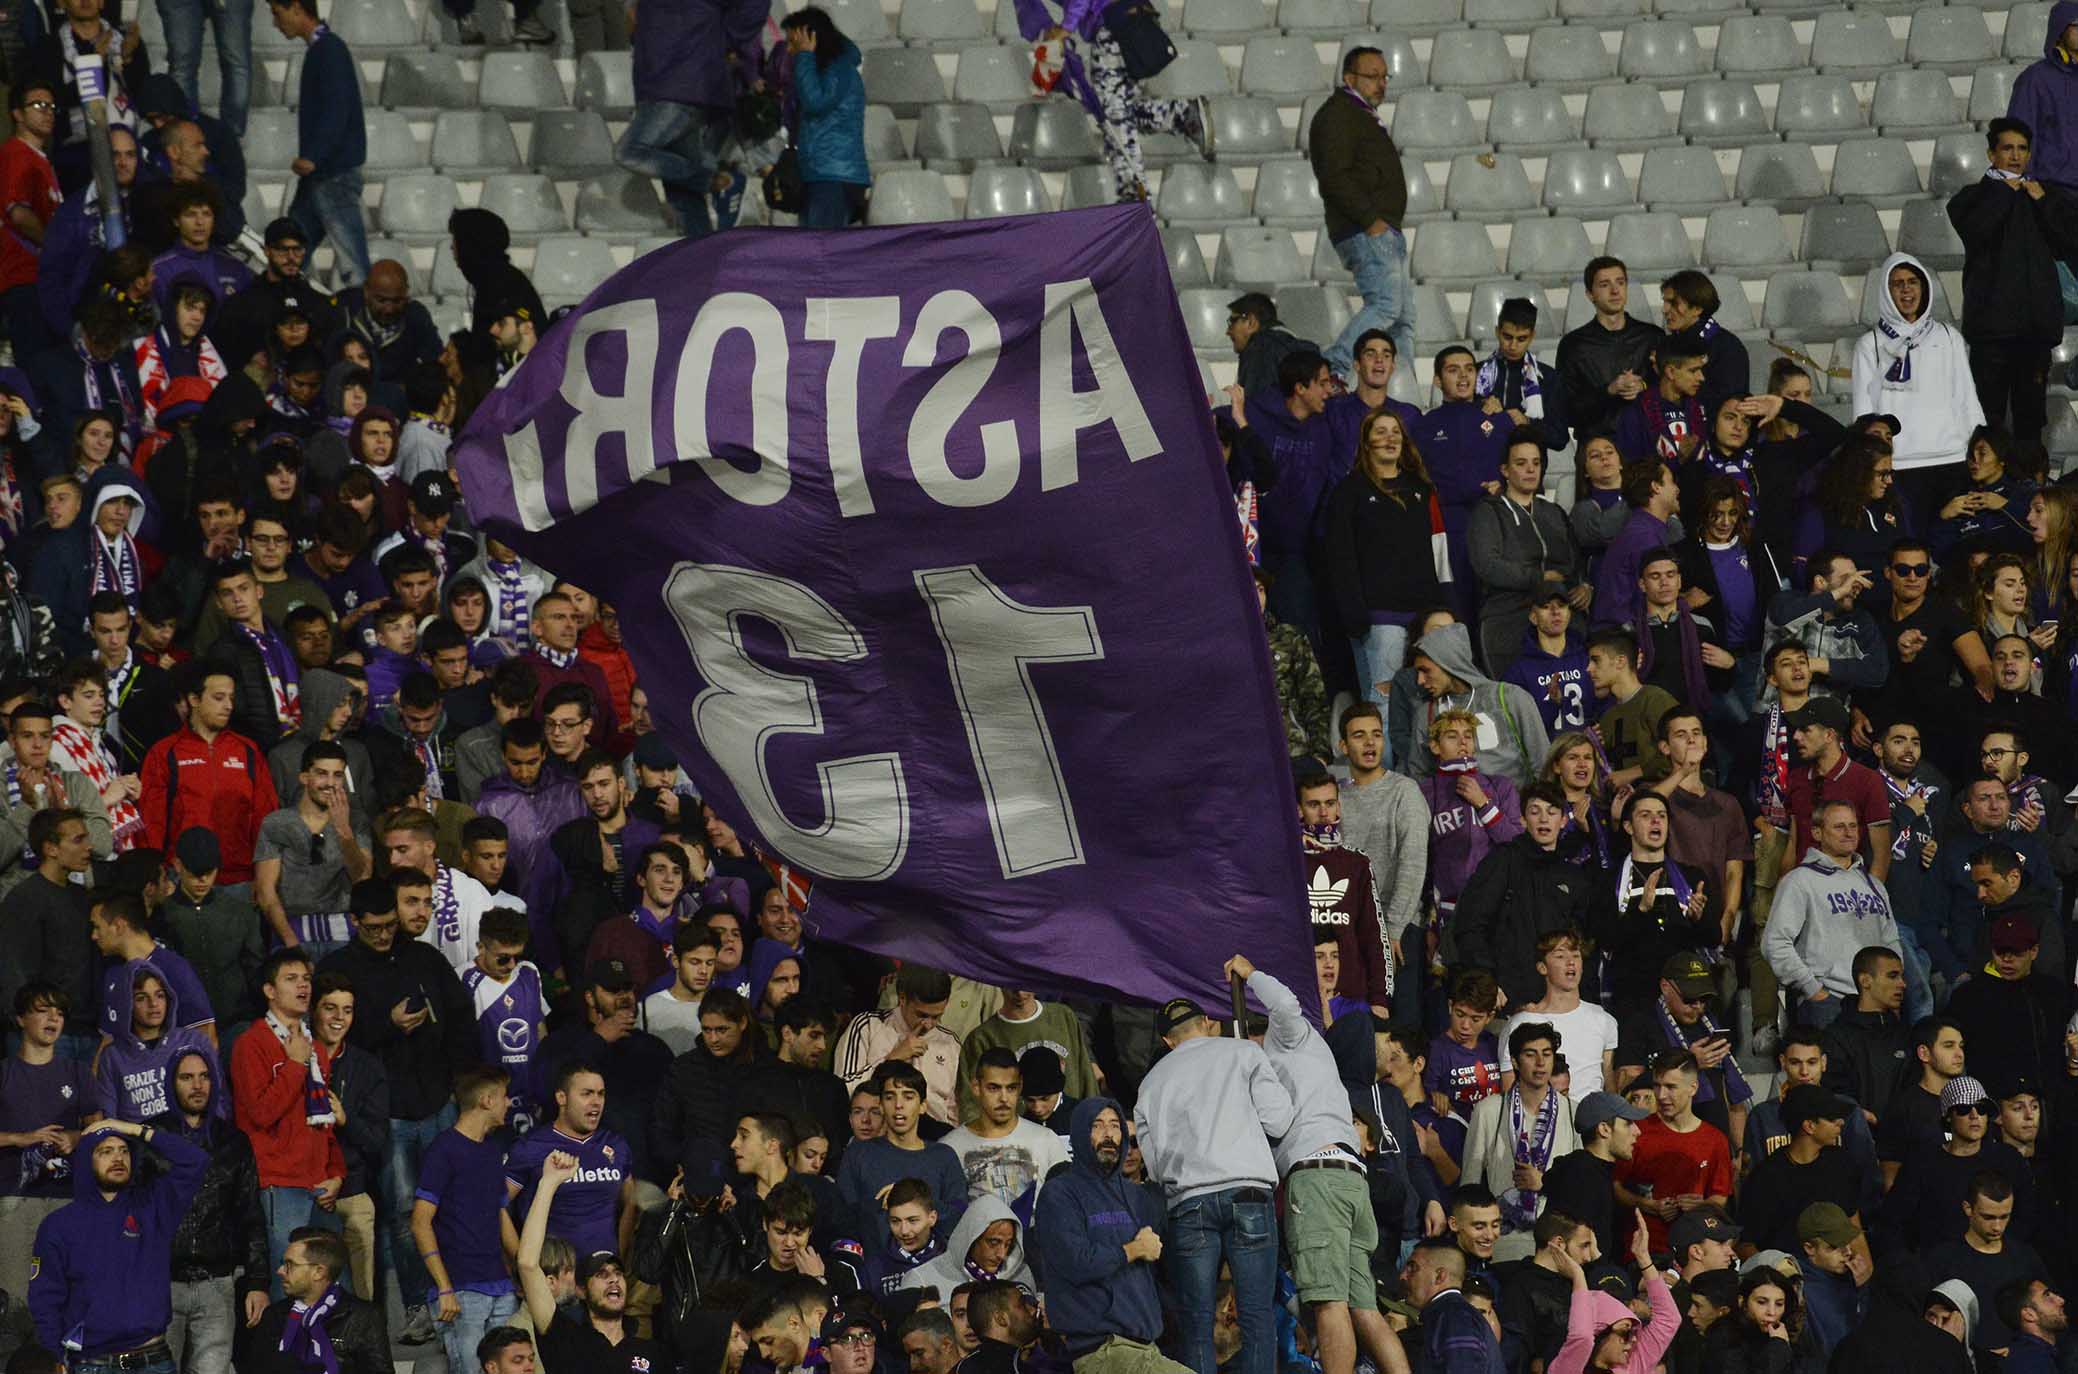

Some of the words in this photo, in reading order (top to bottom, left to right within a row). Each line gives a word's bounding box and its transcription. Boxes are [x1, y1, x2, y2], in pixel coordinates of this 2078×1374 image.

[1827, 892, 1849, 915] 19
[123, 1069, 158, 1090] GRAZIE
[131, 1085, 155, 1105] NON
